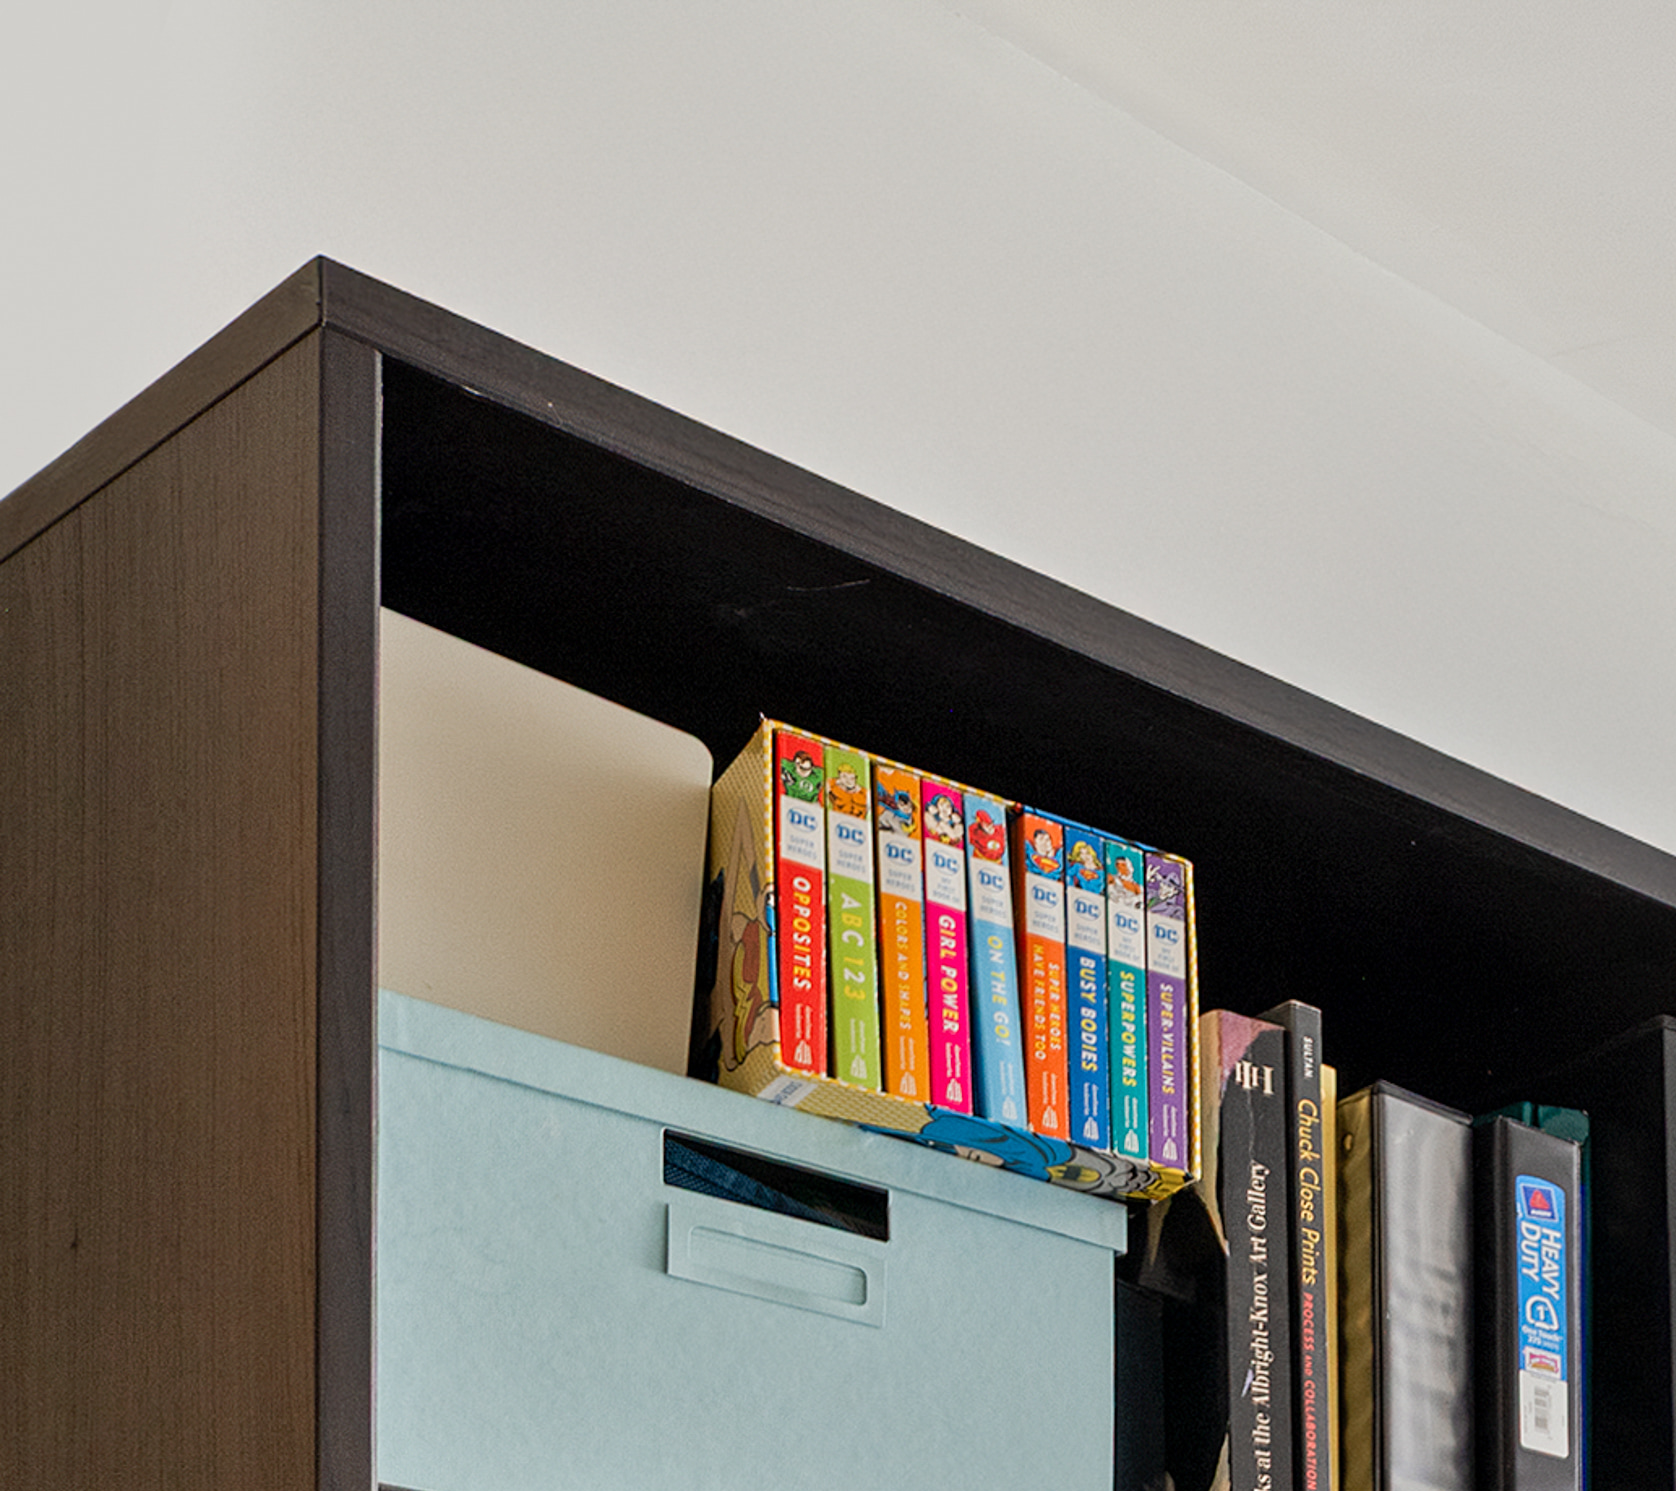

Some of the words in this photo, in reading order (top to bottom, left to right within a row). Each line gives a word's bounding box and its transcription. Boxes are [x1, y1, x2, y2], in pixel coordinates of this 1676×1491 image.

[789, 808, 816, 831] DC
[837, 824, 864, 846] DC
[886, 843, 913, 863] DC
[933, 853, 958, 874] DC
[978, 870, 1004, 889] DC
[1033, 885, 1057, 906] DC
[895, 901, 908, 950] COLORS
[1074, 899, 1100, 920] DC
[1115, 912, 1138, 933] DC
[792, 876, 812, 990] OPPOSITES
[938, 914, 957, 959] GIRL
[987, 935, 1005, 964] ON
[1154, 925, 1178, 944] DC
[940, 965, 960, 1033] POWER
[991, 970, 1008, 1006] THE
[1079, 956, 1096, 1004] BUSY
[1080, 1007, 1099, 1073] BODIES
[1120, 970, 1137, 1088] SUPERPOWERS
[1303, 1036, 1313, 1078] SULTAN
[1297, 1098, 1321, 1163] Chuck
[1246, 1159, 1270, 1231] Gallery
[1299, 1166, 1321, 1222] Close
[1250, 1237, 1267, 1266] Art
[1300, 1227, 1321, 1285] Prints
[1520, 1220, 1541, 1281] DUTY
[1541, 1226, 1562, 1300] HEAVY
[1250, 1272, 1274, 1408] Albright-Knox
[1303, 1292, 1315, 1352] PROCESS
[1251, 1413, 1272, 1445] the
[1303, 1379, 1317, 1491] COLLABORATION
[1254, 1451, 1272, 1470] at
